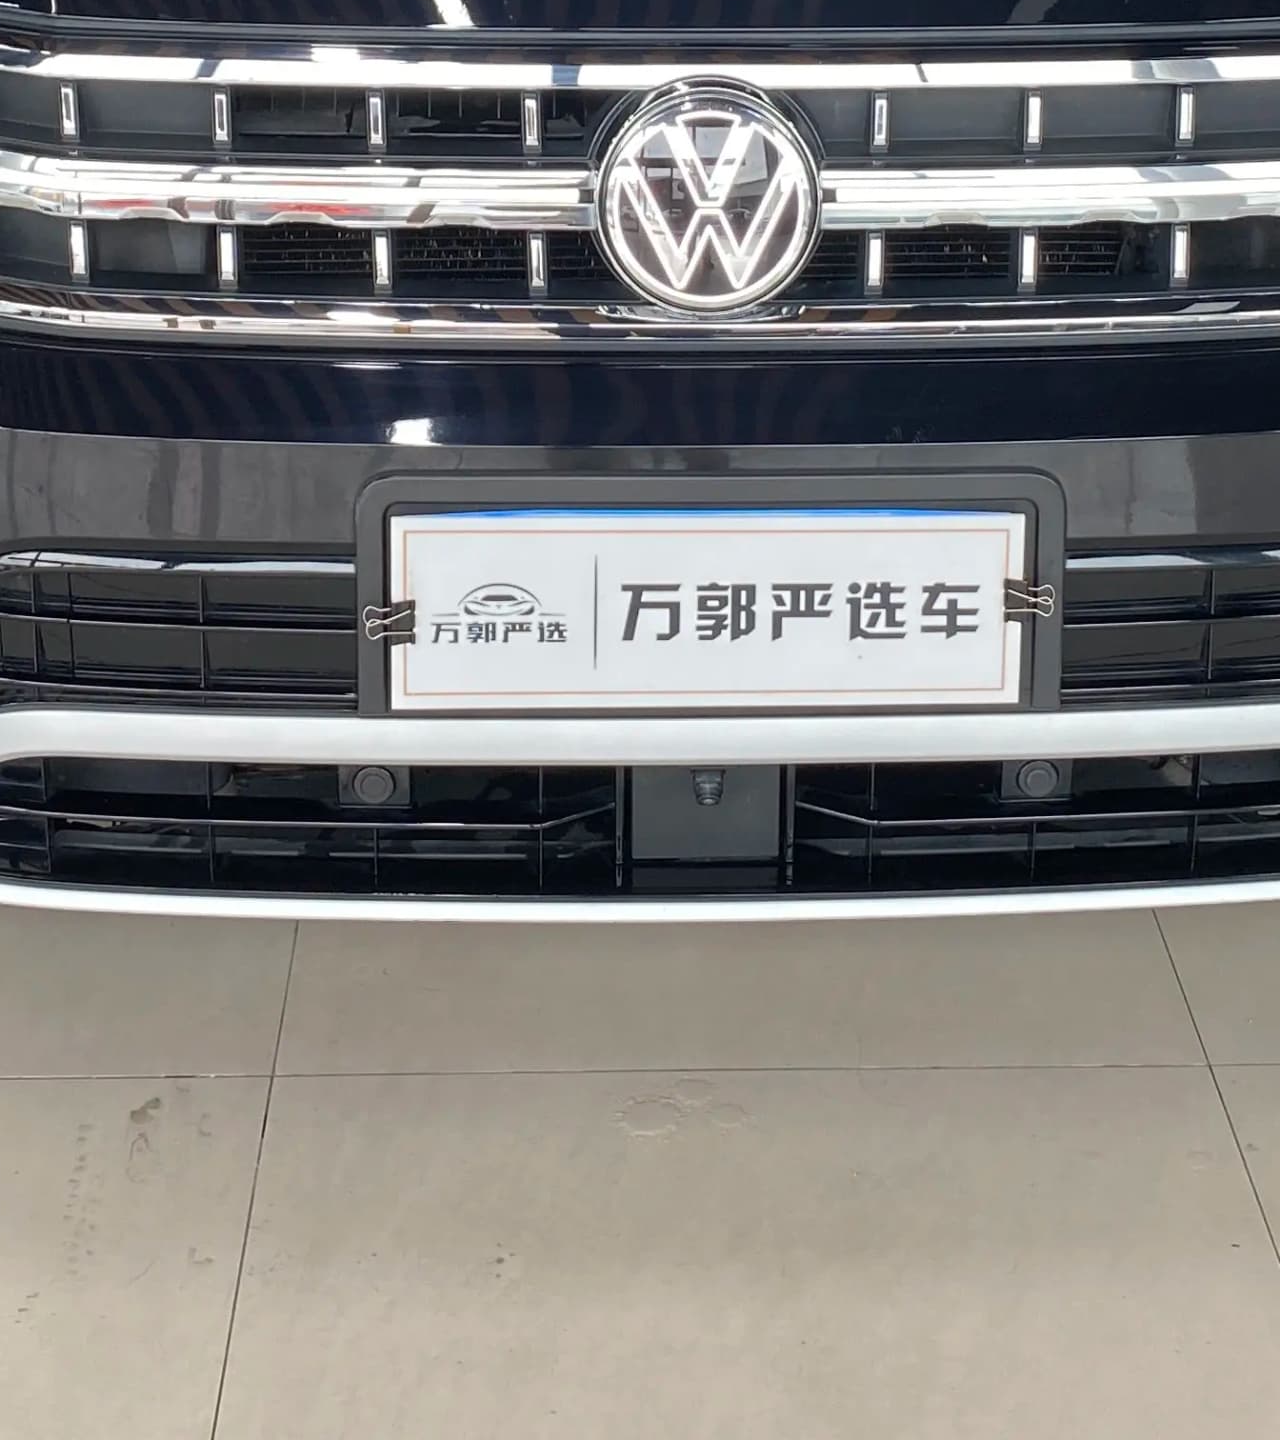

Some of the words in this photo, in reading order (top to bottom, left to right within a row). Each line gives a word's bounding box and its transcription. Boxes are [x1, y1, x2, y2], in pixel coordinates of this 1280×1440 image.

[429, 620, 569, 645] 万郭严选
[619, 581, 982, 643] 万郭严选车
